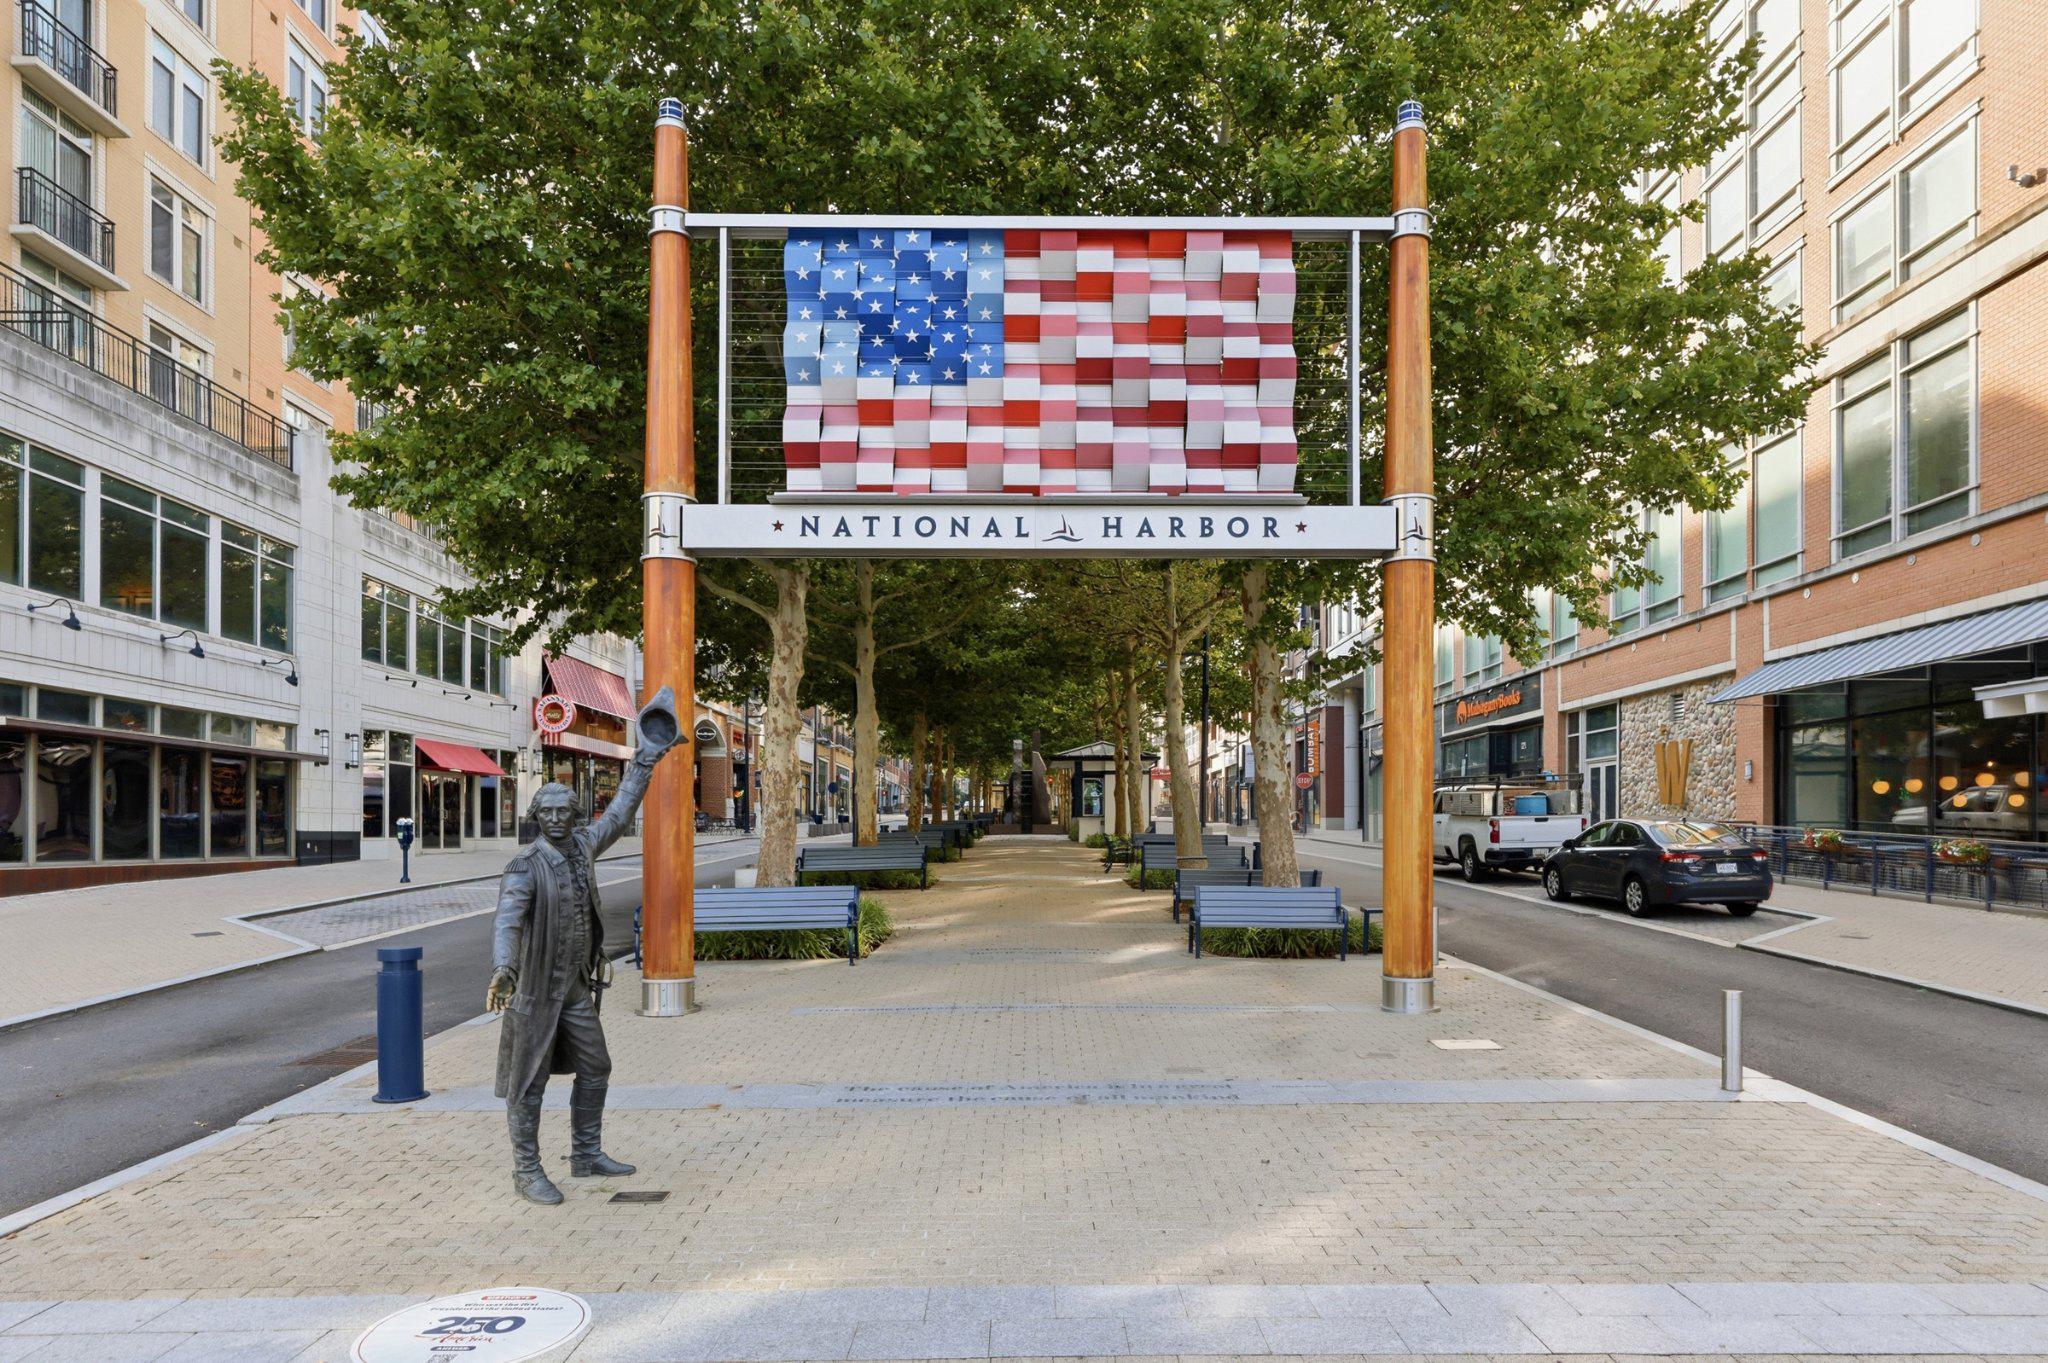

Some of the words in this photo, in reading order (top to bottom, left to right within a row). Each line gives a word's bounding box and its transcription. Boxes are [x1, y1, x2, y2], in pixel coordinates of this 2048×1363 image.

[800, 516, 1030, 538] NATIONAL
[1102, 516, 1280, 538] HARBOR
[1307, 726, 1315, 773] BOMBAY
[422, 1316, 526, 1334] 250
